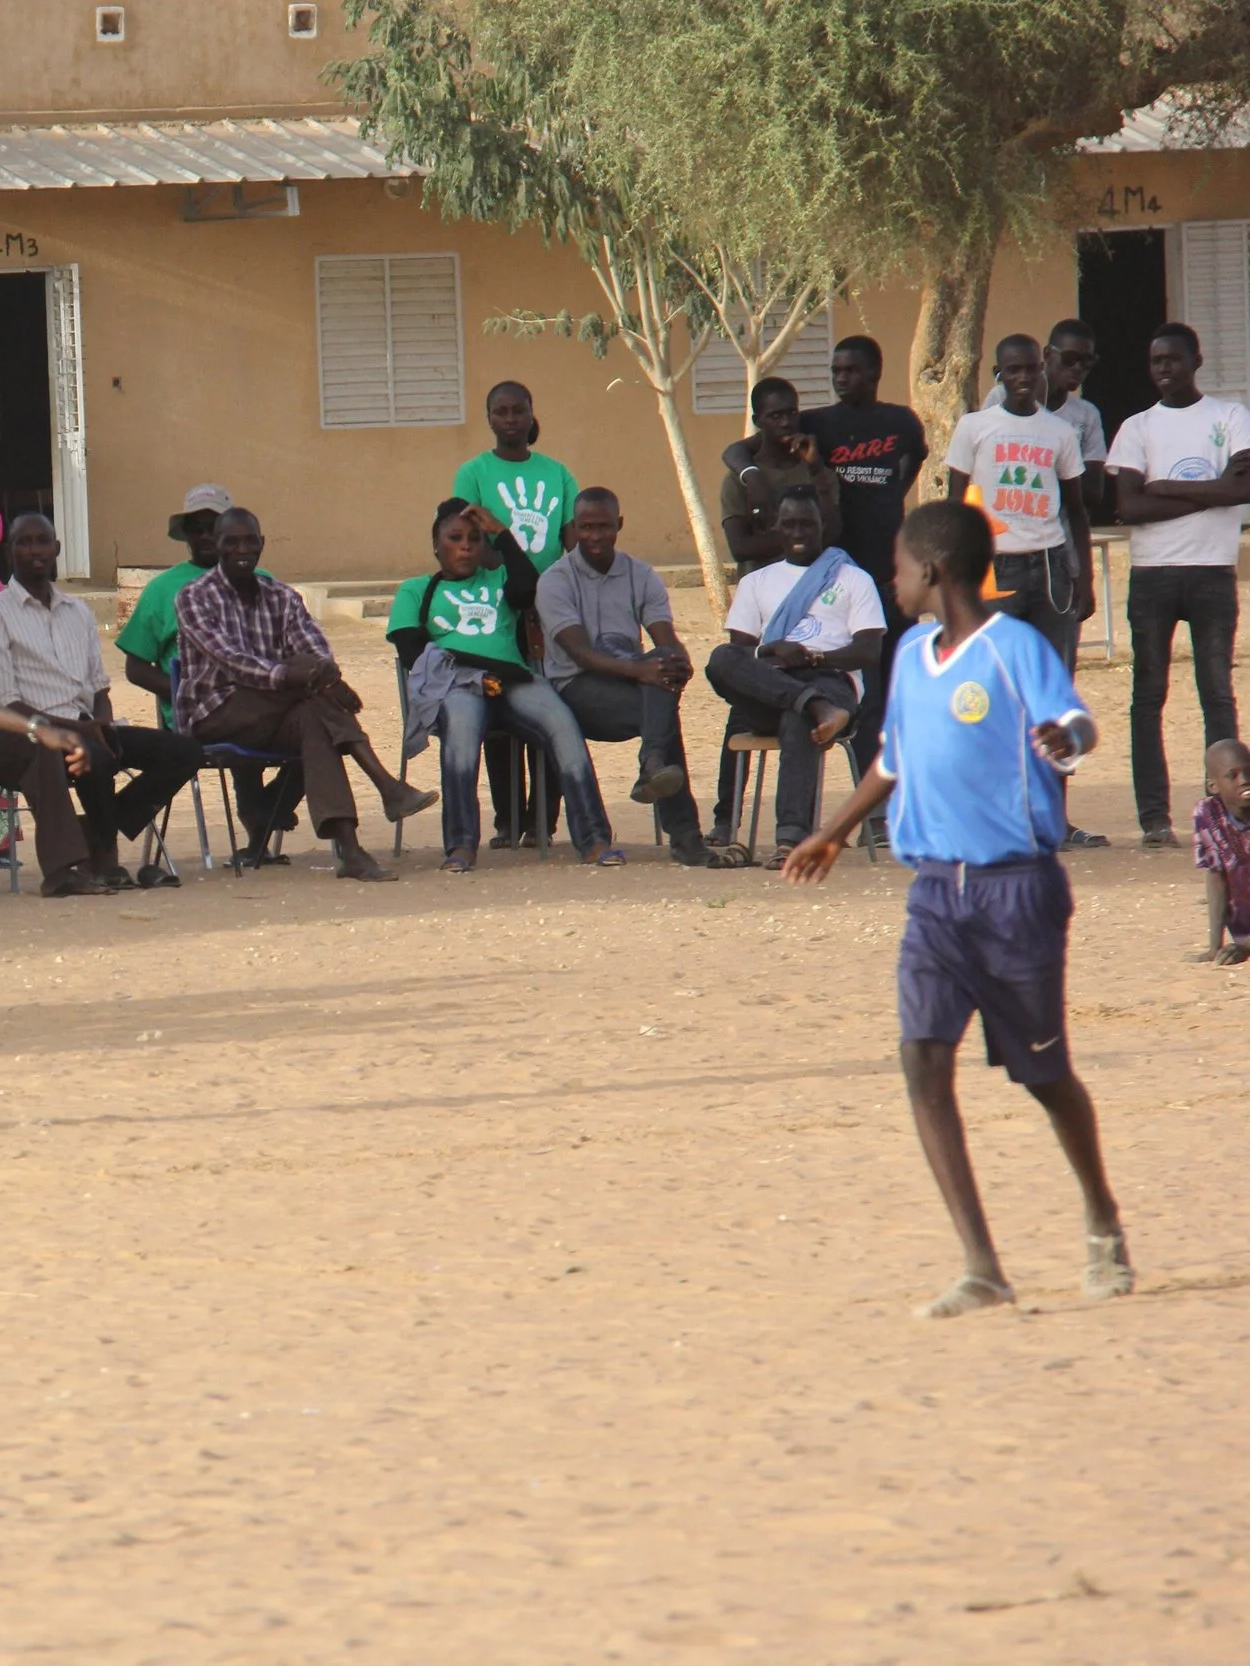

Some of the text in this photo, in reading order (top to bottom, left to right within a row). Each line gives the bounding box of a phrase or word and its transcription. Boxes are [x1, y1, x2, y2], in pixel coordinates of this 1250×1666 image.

[1097, 184, 1162, 217] 4M4
[830, 435, 899, 464] DARE
[995, 443, 1054, 468] BROKE
[999, 465, 1044, 489] AS A
[992, 487, 1051, 518] JOKE
